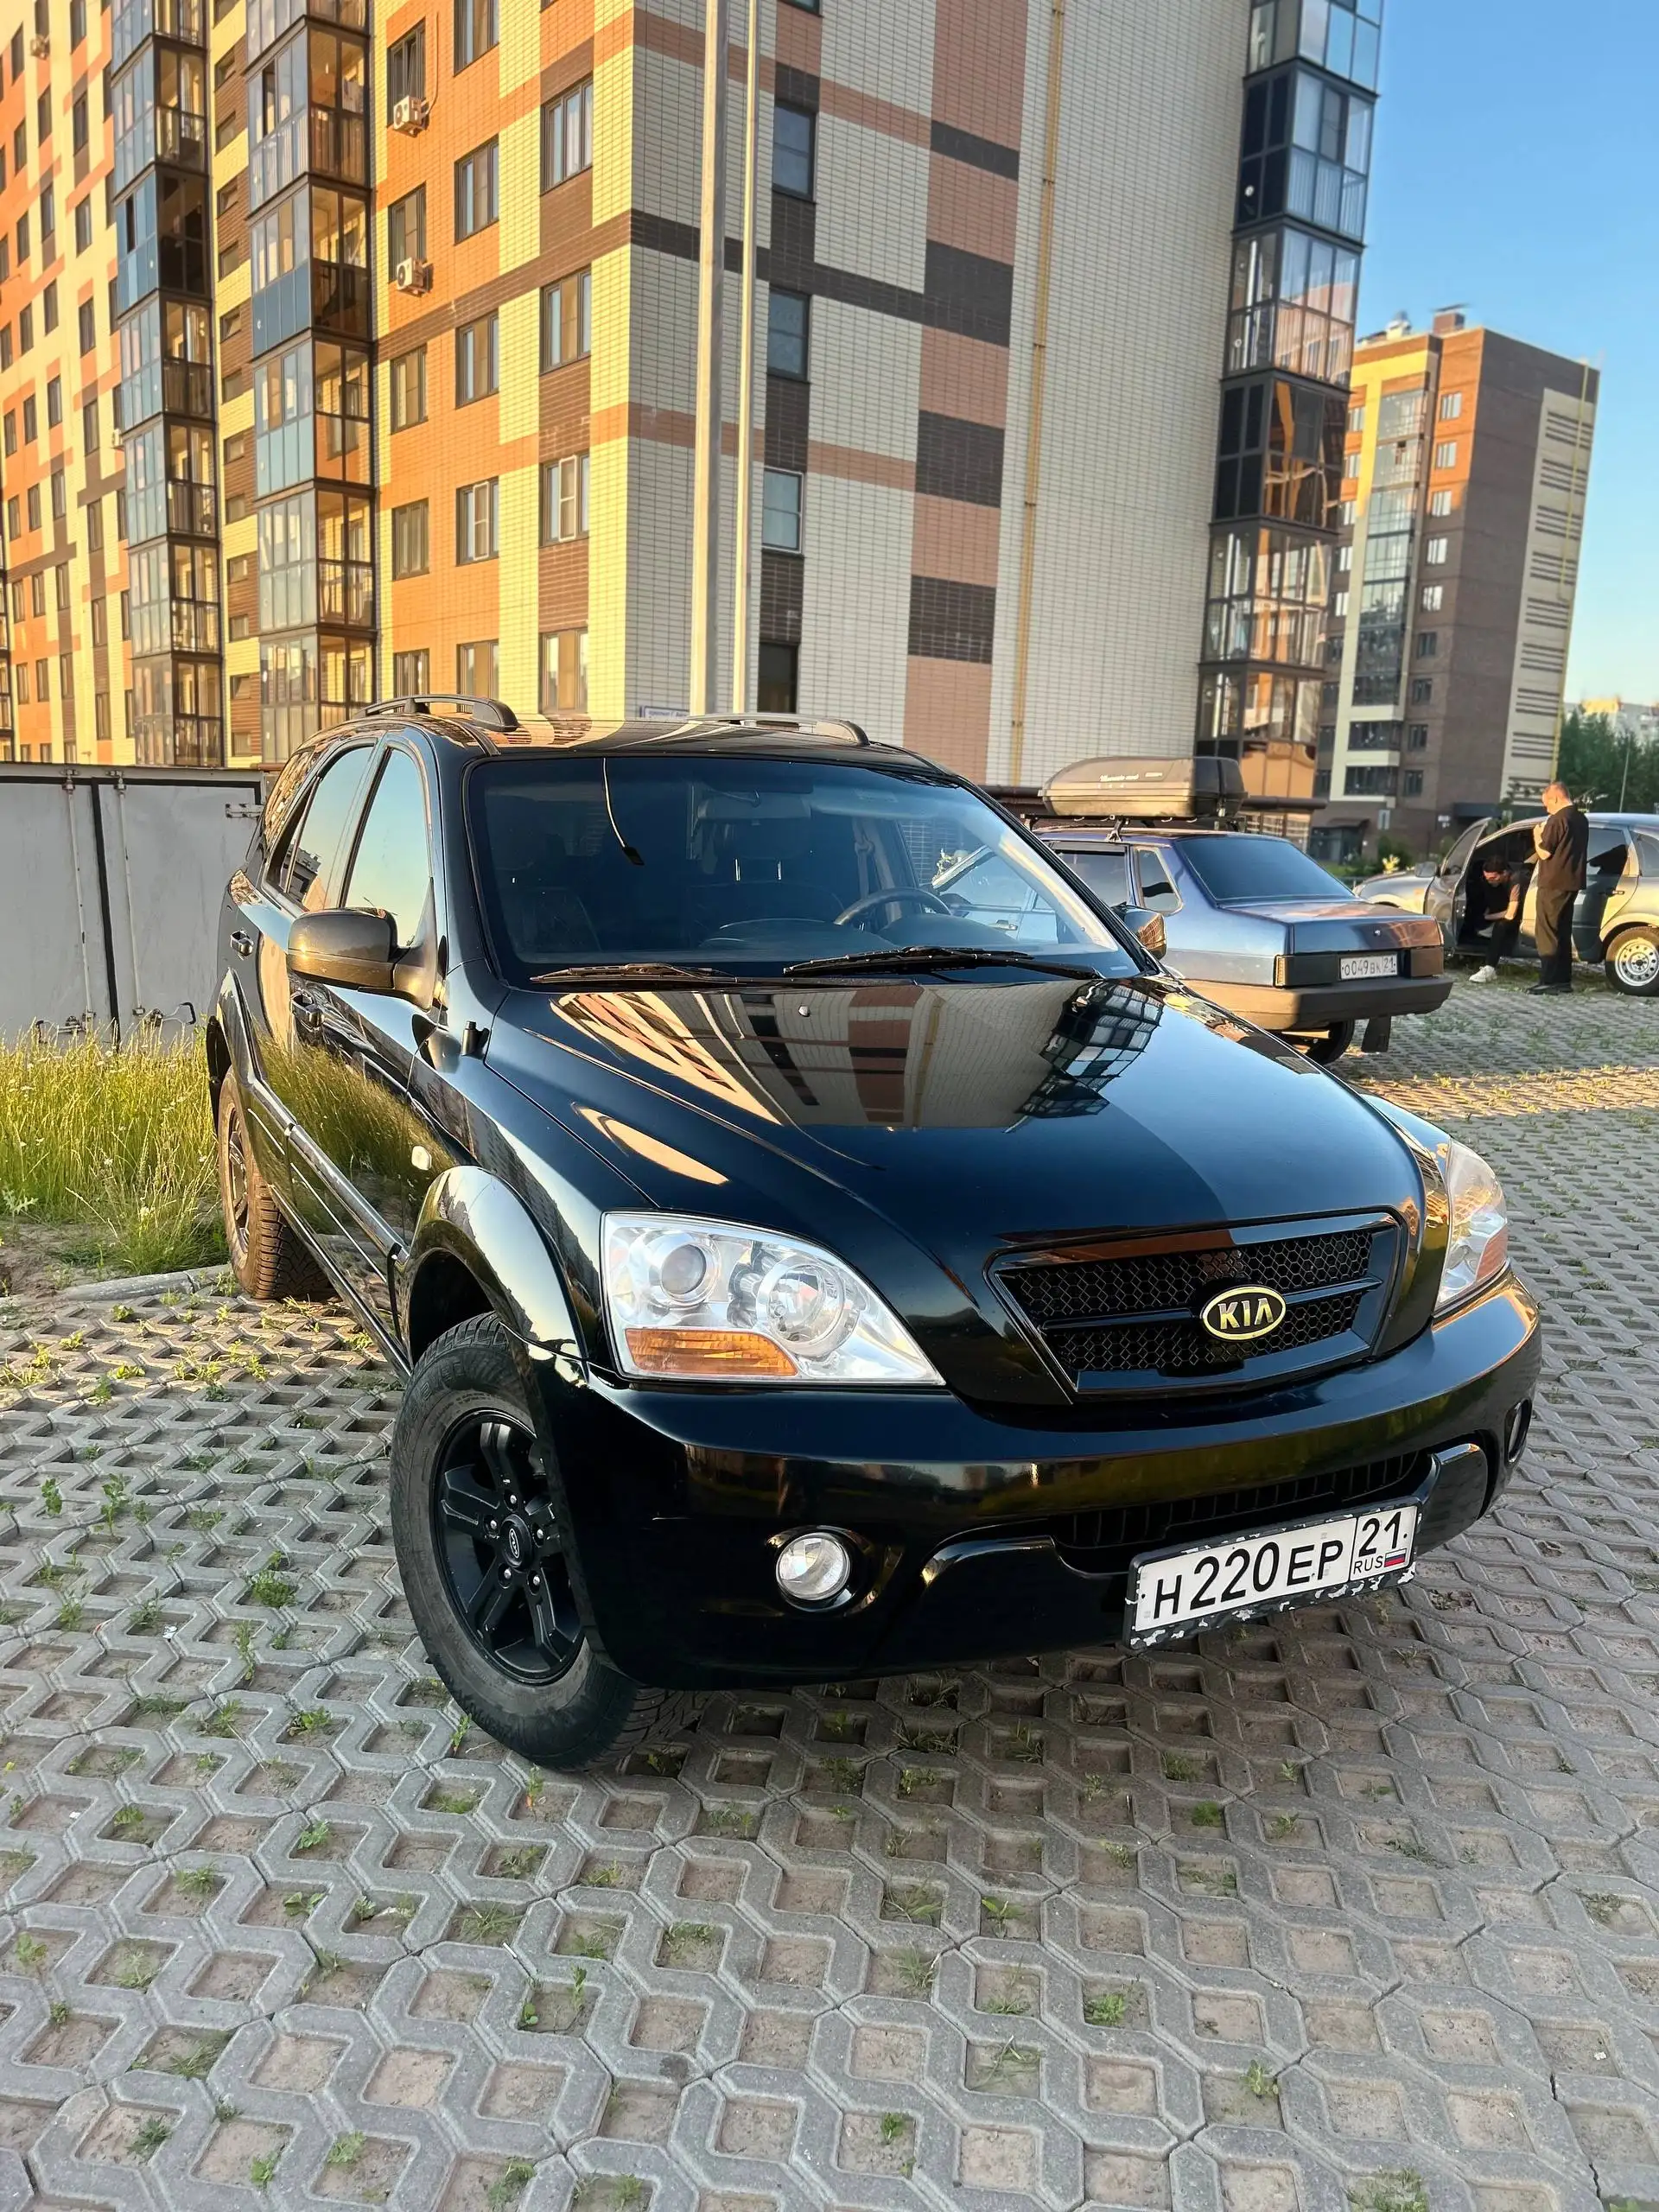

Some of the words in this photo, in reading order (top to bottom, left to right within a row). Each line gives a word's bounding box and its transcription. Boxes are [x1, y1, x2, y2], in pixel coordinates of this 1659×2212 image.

[1383, 957, 1394, 969] 21
[1217, 1297, 1274, 1330] KIA
[1358, 1511, 1402, 1556] 21
[1353, 1554, 1384, 1575] RUS
